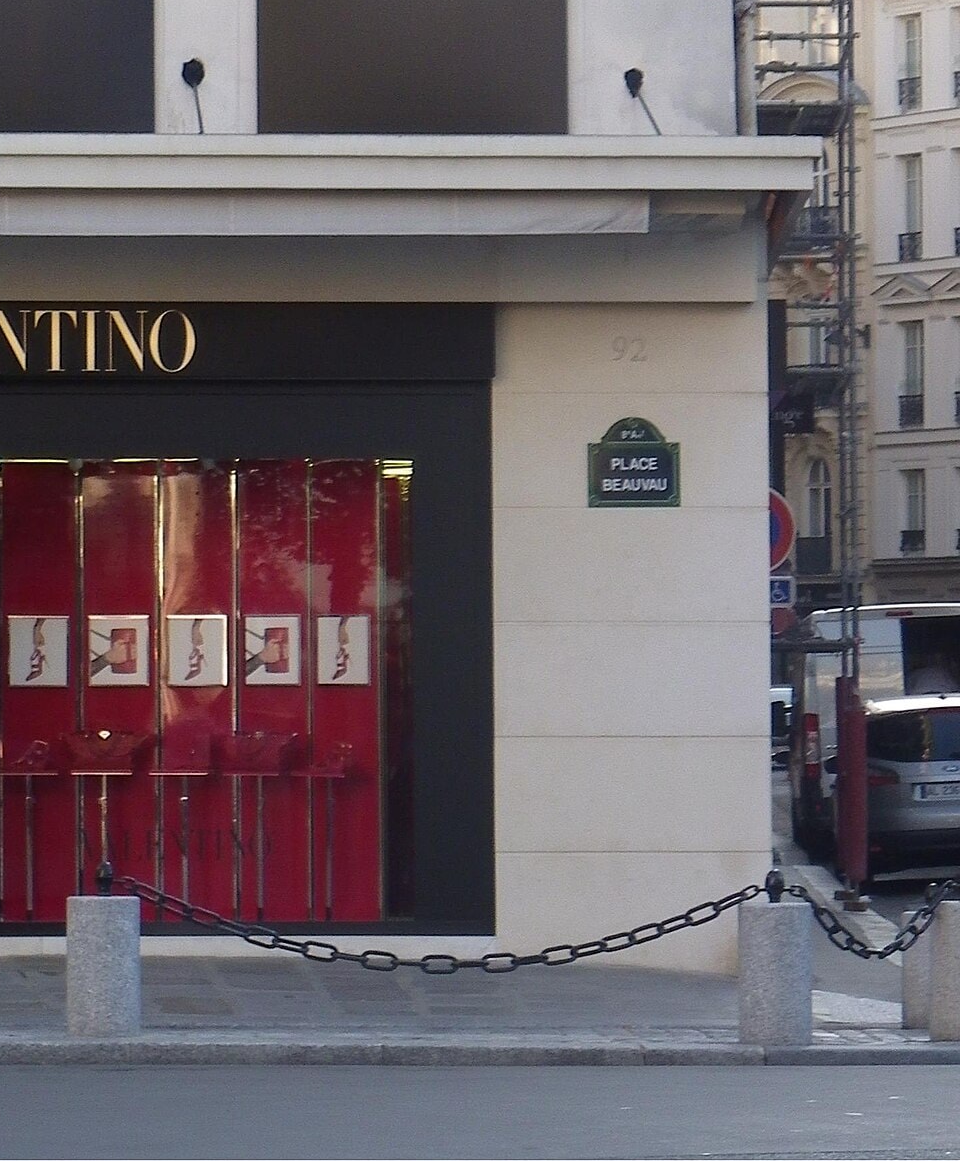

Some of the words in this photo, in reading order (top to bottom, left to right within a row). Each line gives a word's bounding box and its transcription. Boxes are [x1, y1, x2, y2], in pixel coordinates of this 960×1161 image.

[610, 336, 647, 362] 92
[610, 457, 659, 471] PLACE
[602, 478, 668, 492] BEAUVAU
